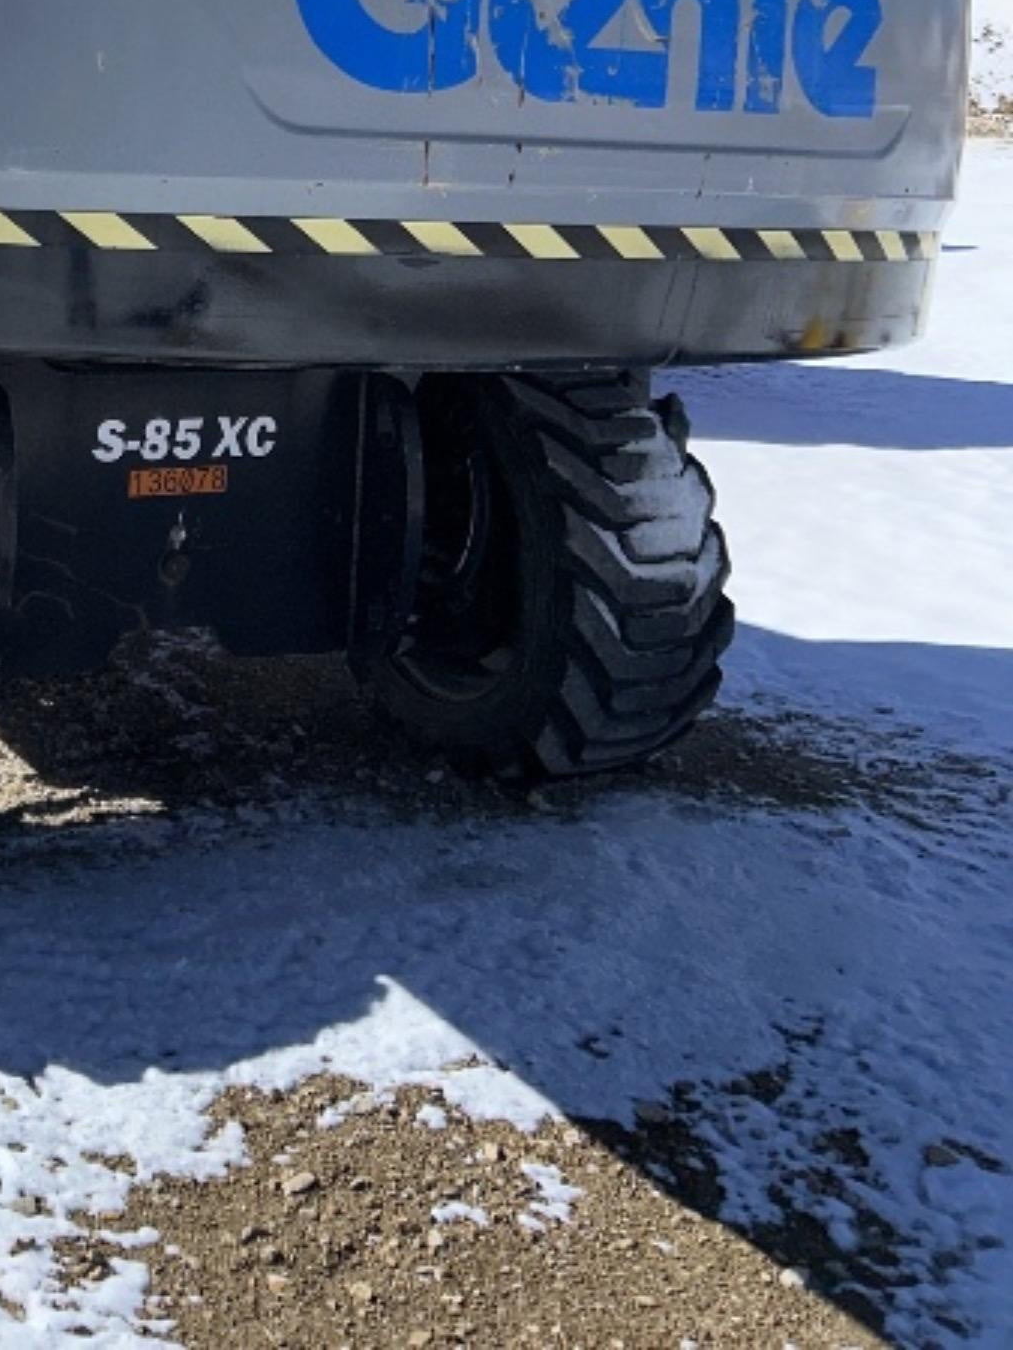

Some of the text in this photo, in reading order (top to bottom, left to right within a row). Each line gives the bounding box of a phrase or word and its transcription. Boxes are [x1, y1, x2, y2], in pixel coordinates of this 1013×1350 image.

[91, 414, 278, 463] S-85 XC
[134, 466, 227, 495] 136078
